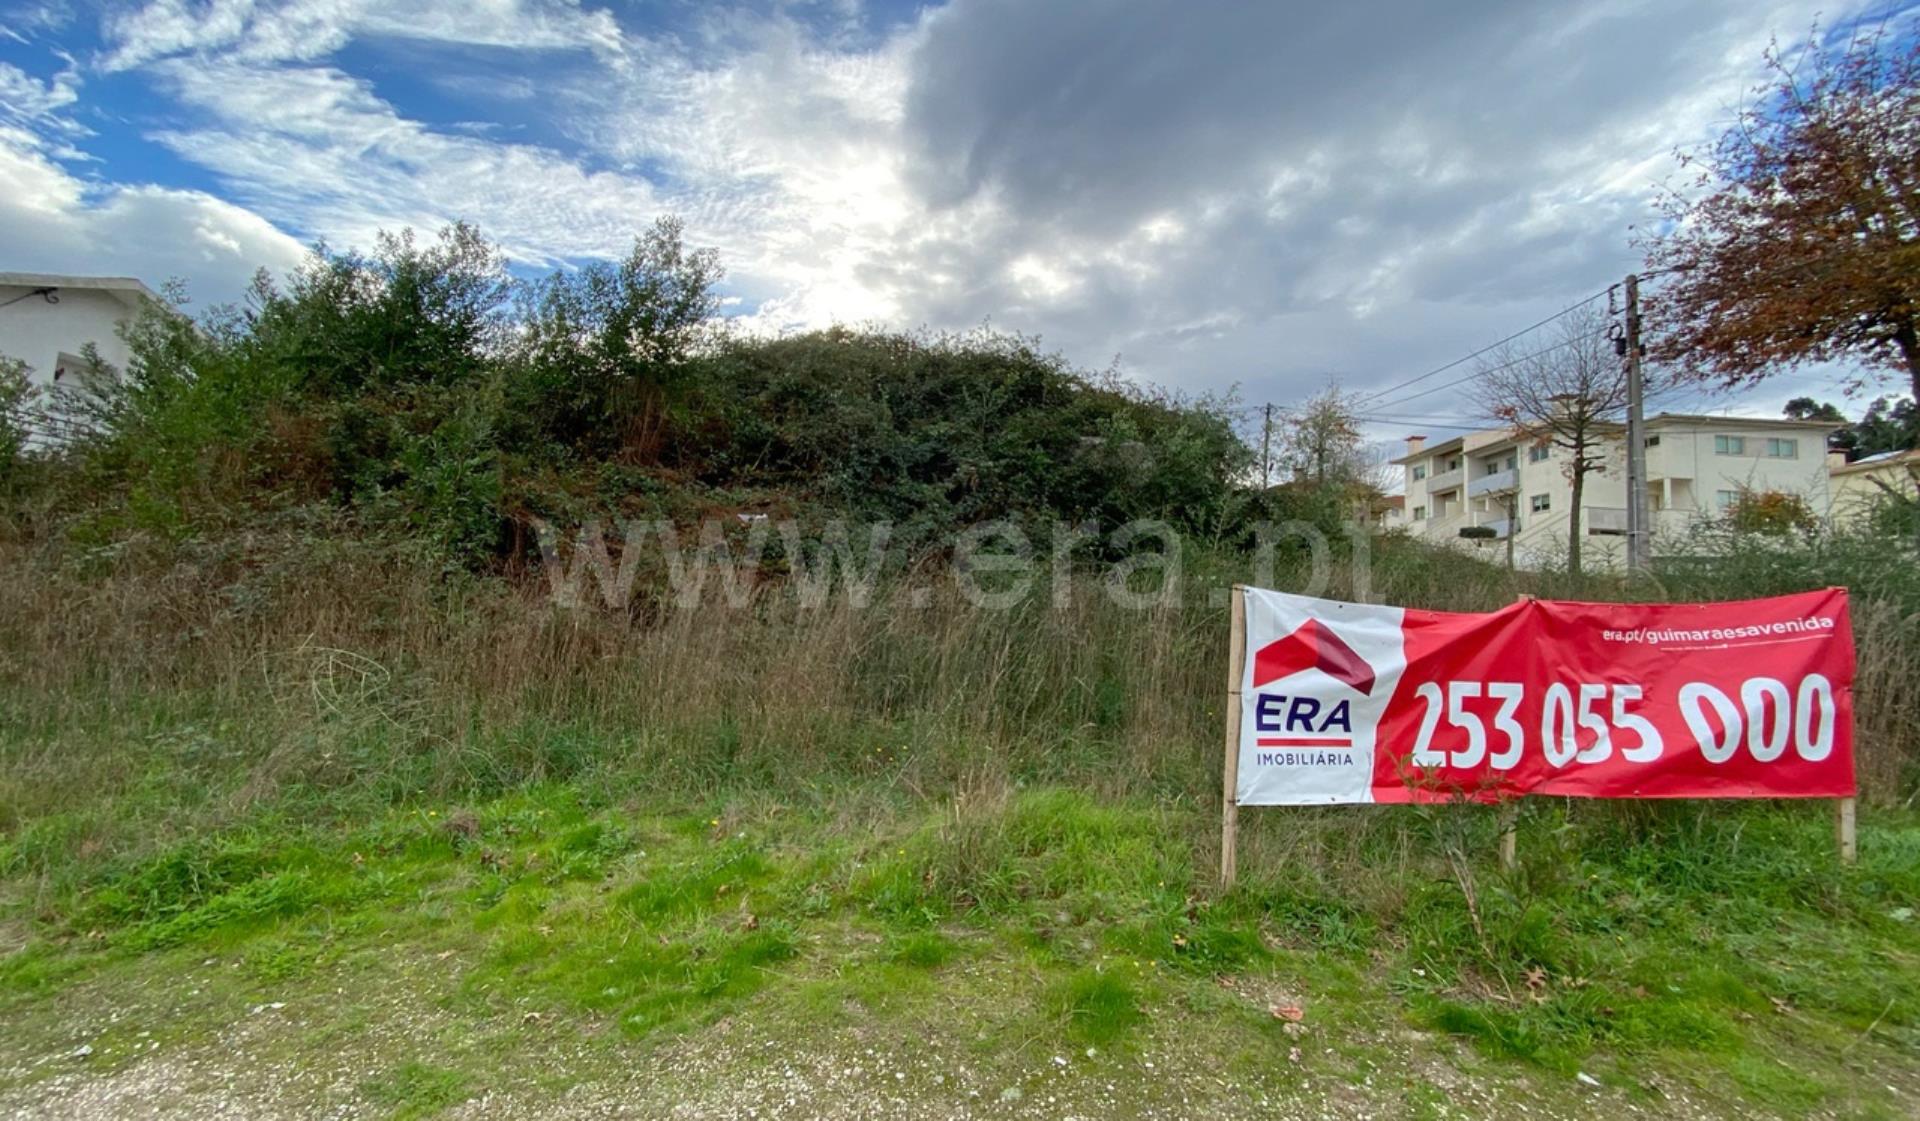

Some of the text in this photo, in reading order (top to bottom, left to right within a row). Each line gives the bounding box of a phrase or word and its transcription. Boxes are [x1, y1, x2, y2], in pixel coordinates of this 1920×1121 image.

[1602, 616, 1835, 644] era.pt/guimaraesavenida
[1255, 693, 1353, 733] ERA
[1411, 673, 1836, 769] 253 055 000
[1256, 749, 1354, 766] IMOBILIÁRIA
